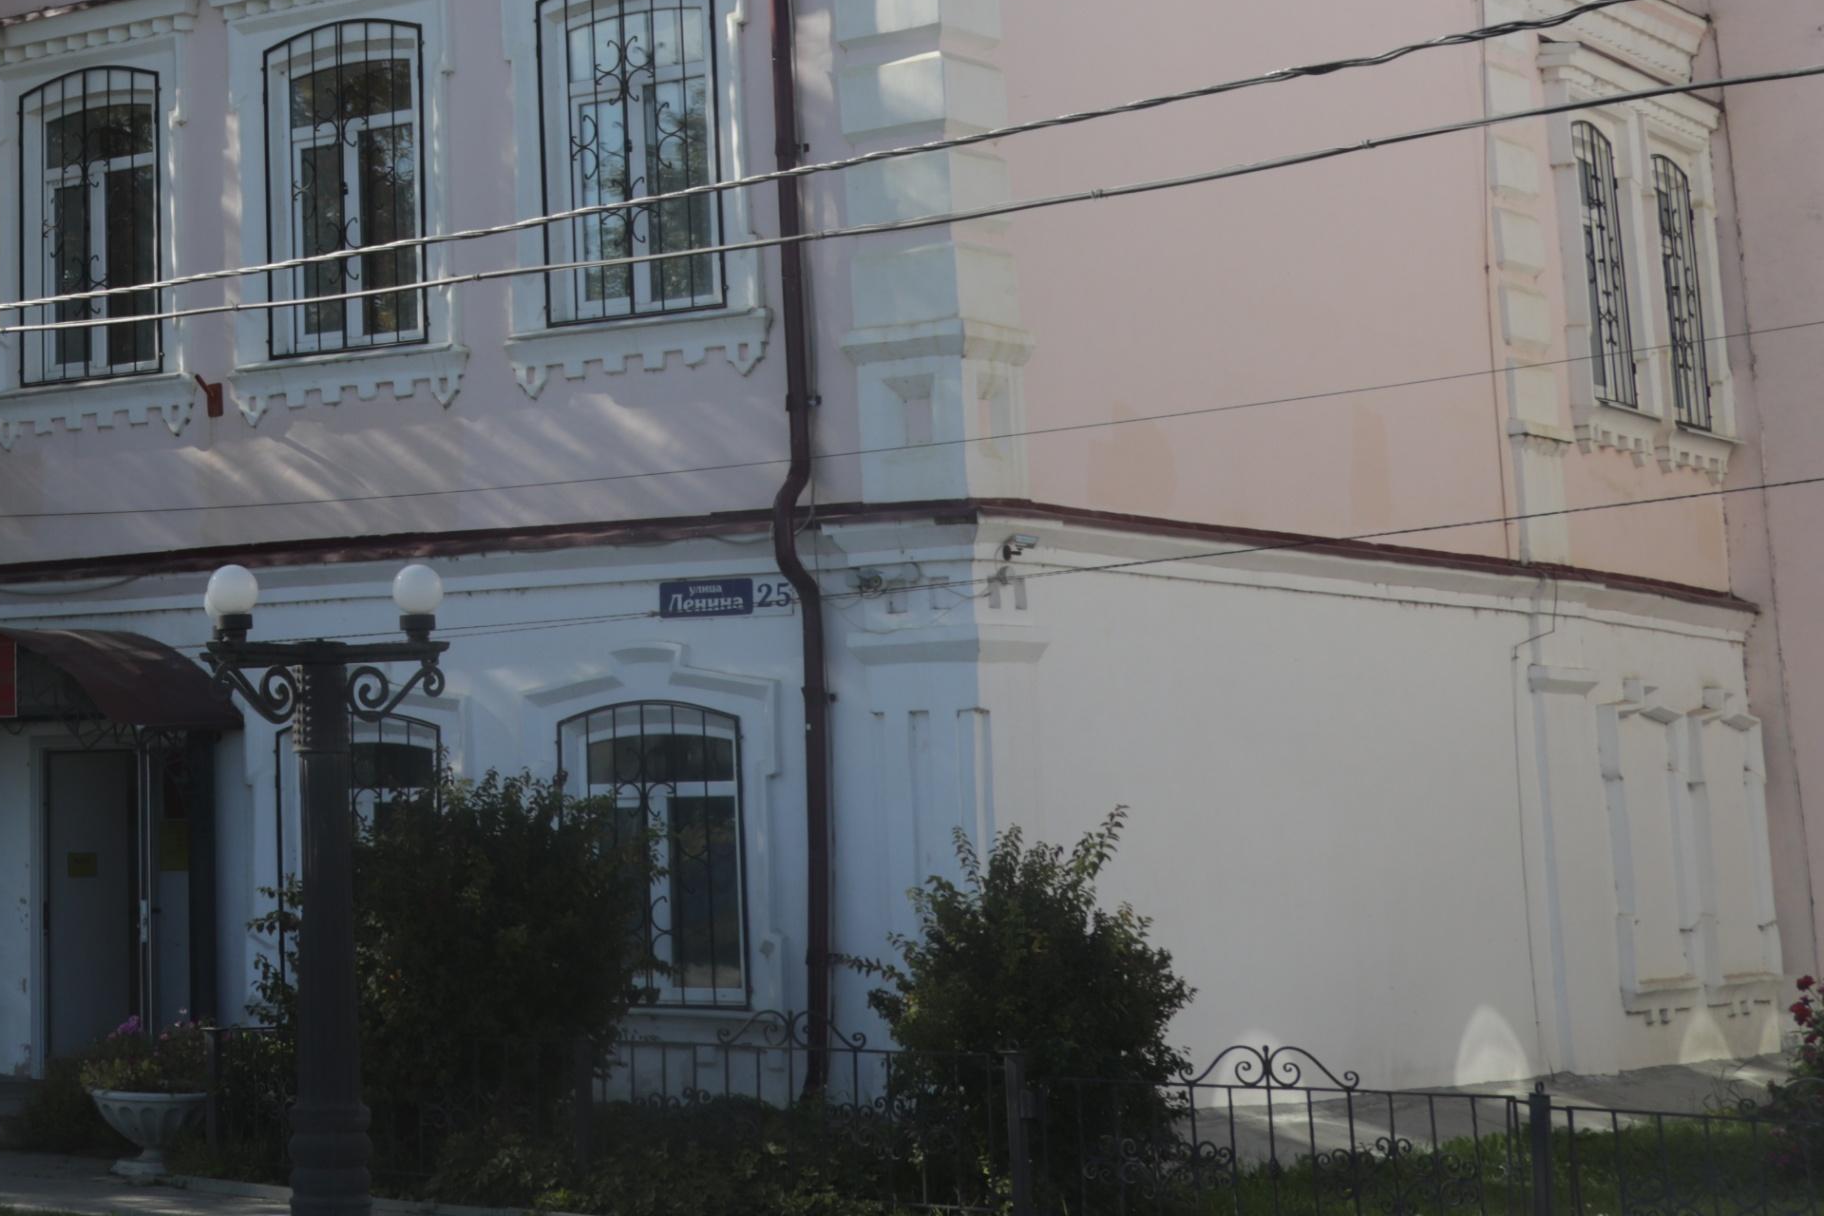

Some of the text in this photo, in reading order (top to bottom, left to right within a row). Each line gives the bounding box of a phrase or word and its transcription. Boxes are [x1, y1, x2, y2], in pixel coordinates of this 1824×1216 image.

[689, 585, 722, 596] улица
[758, 583, 791, 607] 25
[669, 594, 744, 613] Ленина
